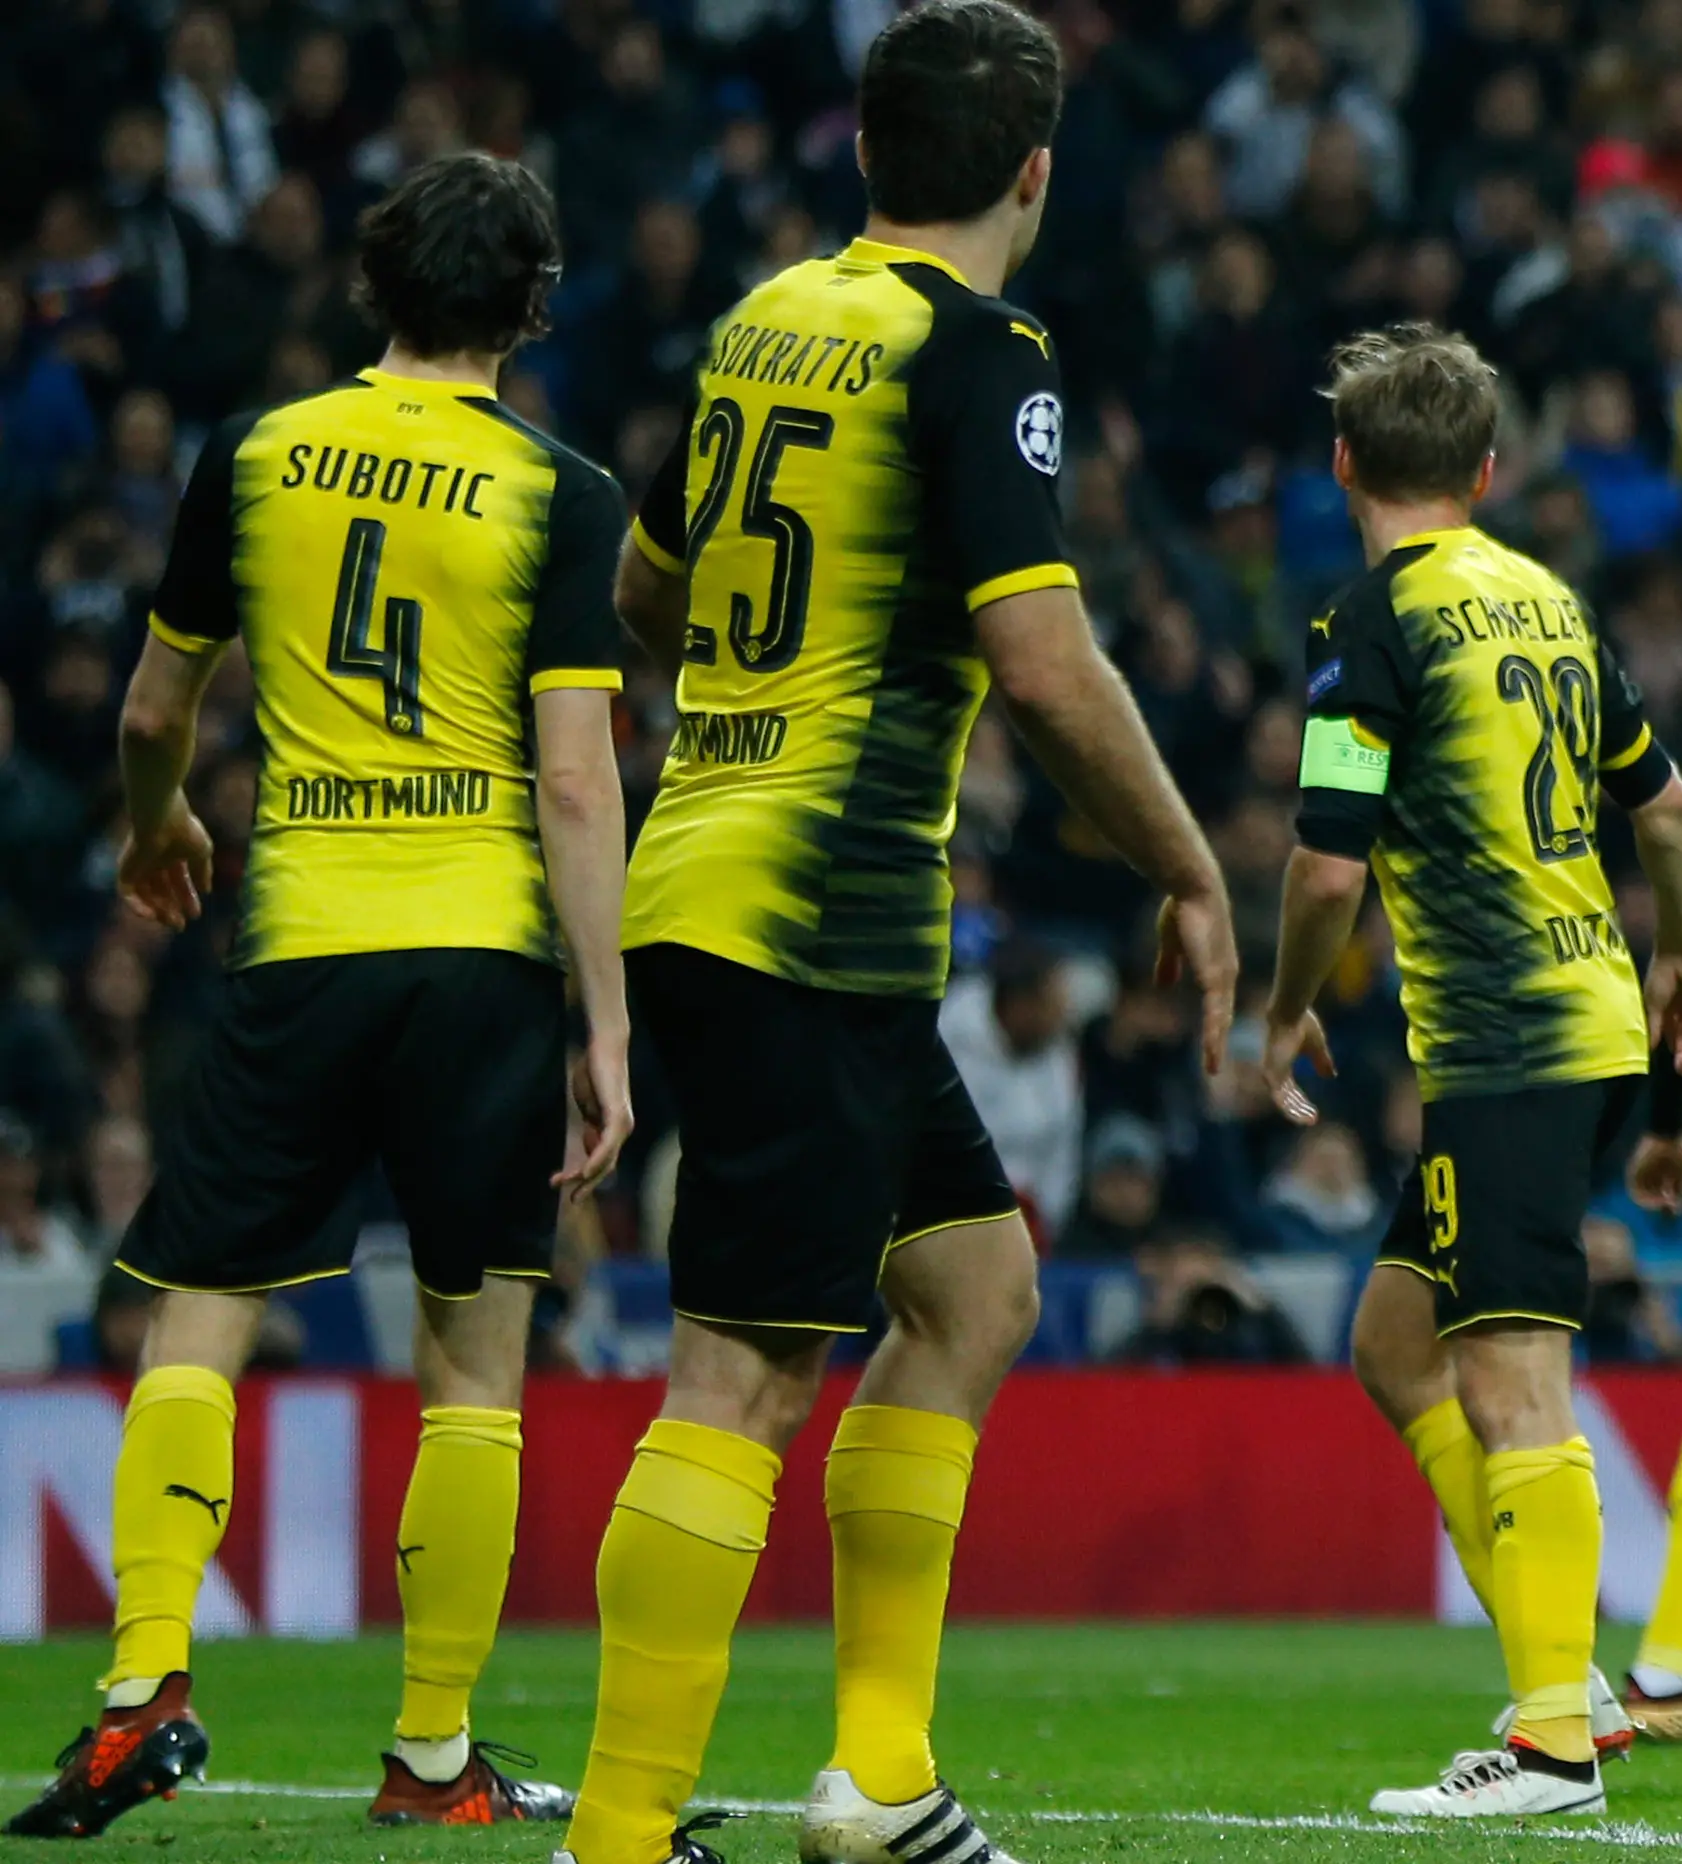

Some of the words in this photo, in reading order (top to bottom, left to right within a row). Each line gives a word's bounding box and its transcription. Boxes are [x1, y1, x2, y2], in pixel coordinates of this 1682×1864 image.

[710, 322, 884, 396] SOKRATIS
[281, 444, 496, 520] SUBOTIC
[683, 397, 835, 674] 25
[327, 517, 424, 738] 4
[288, 771, 490, 820] DORTMUND
[1497, 654, 1596, 864] 29
